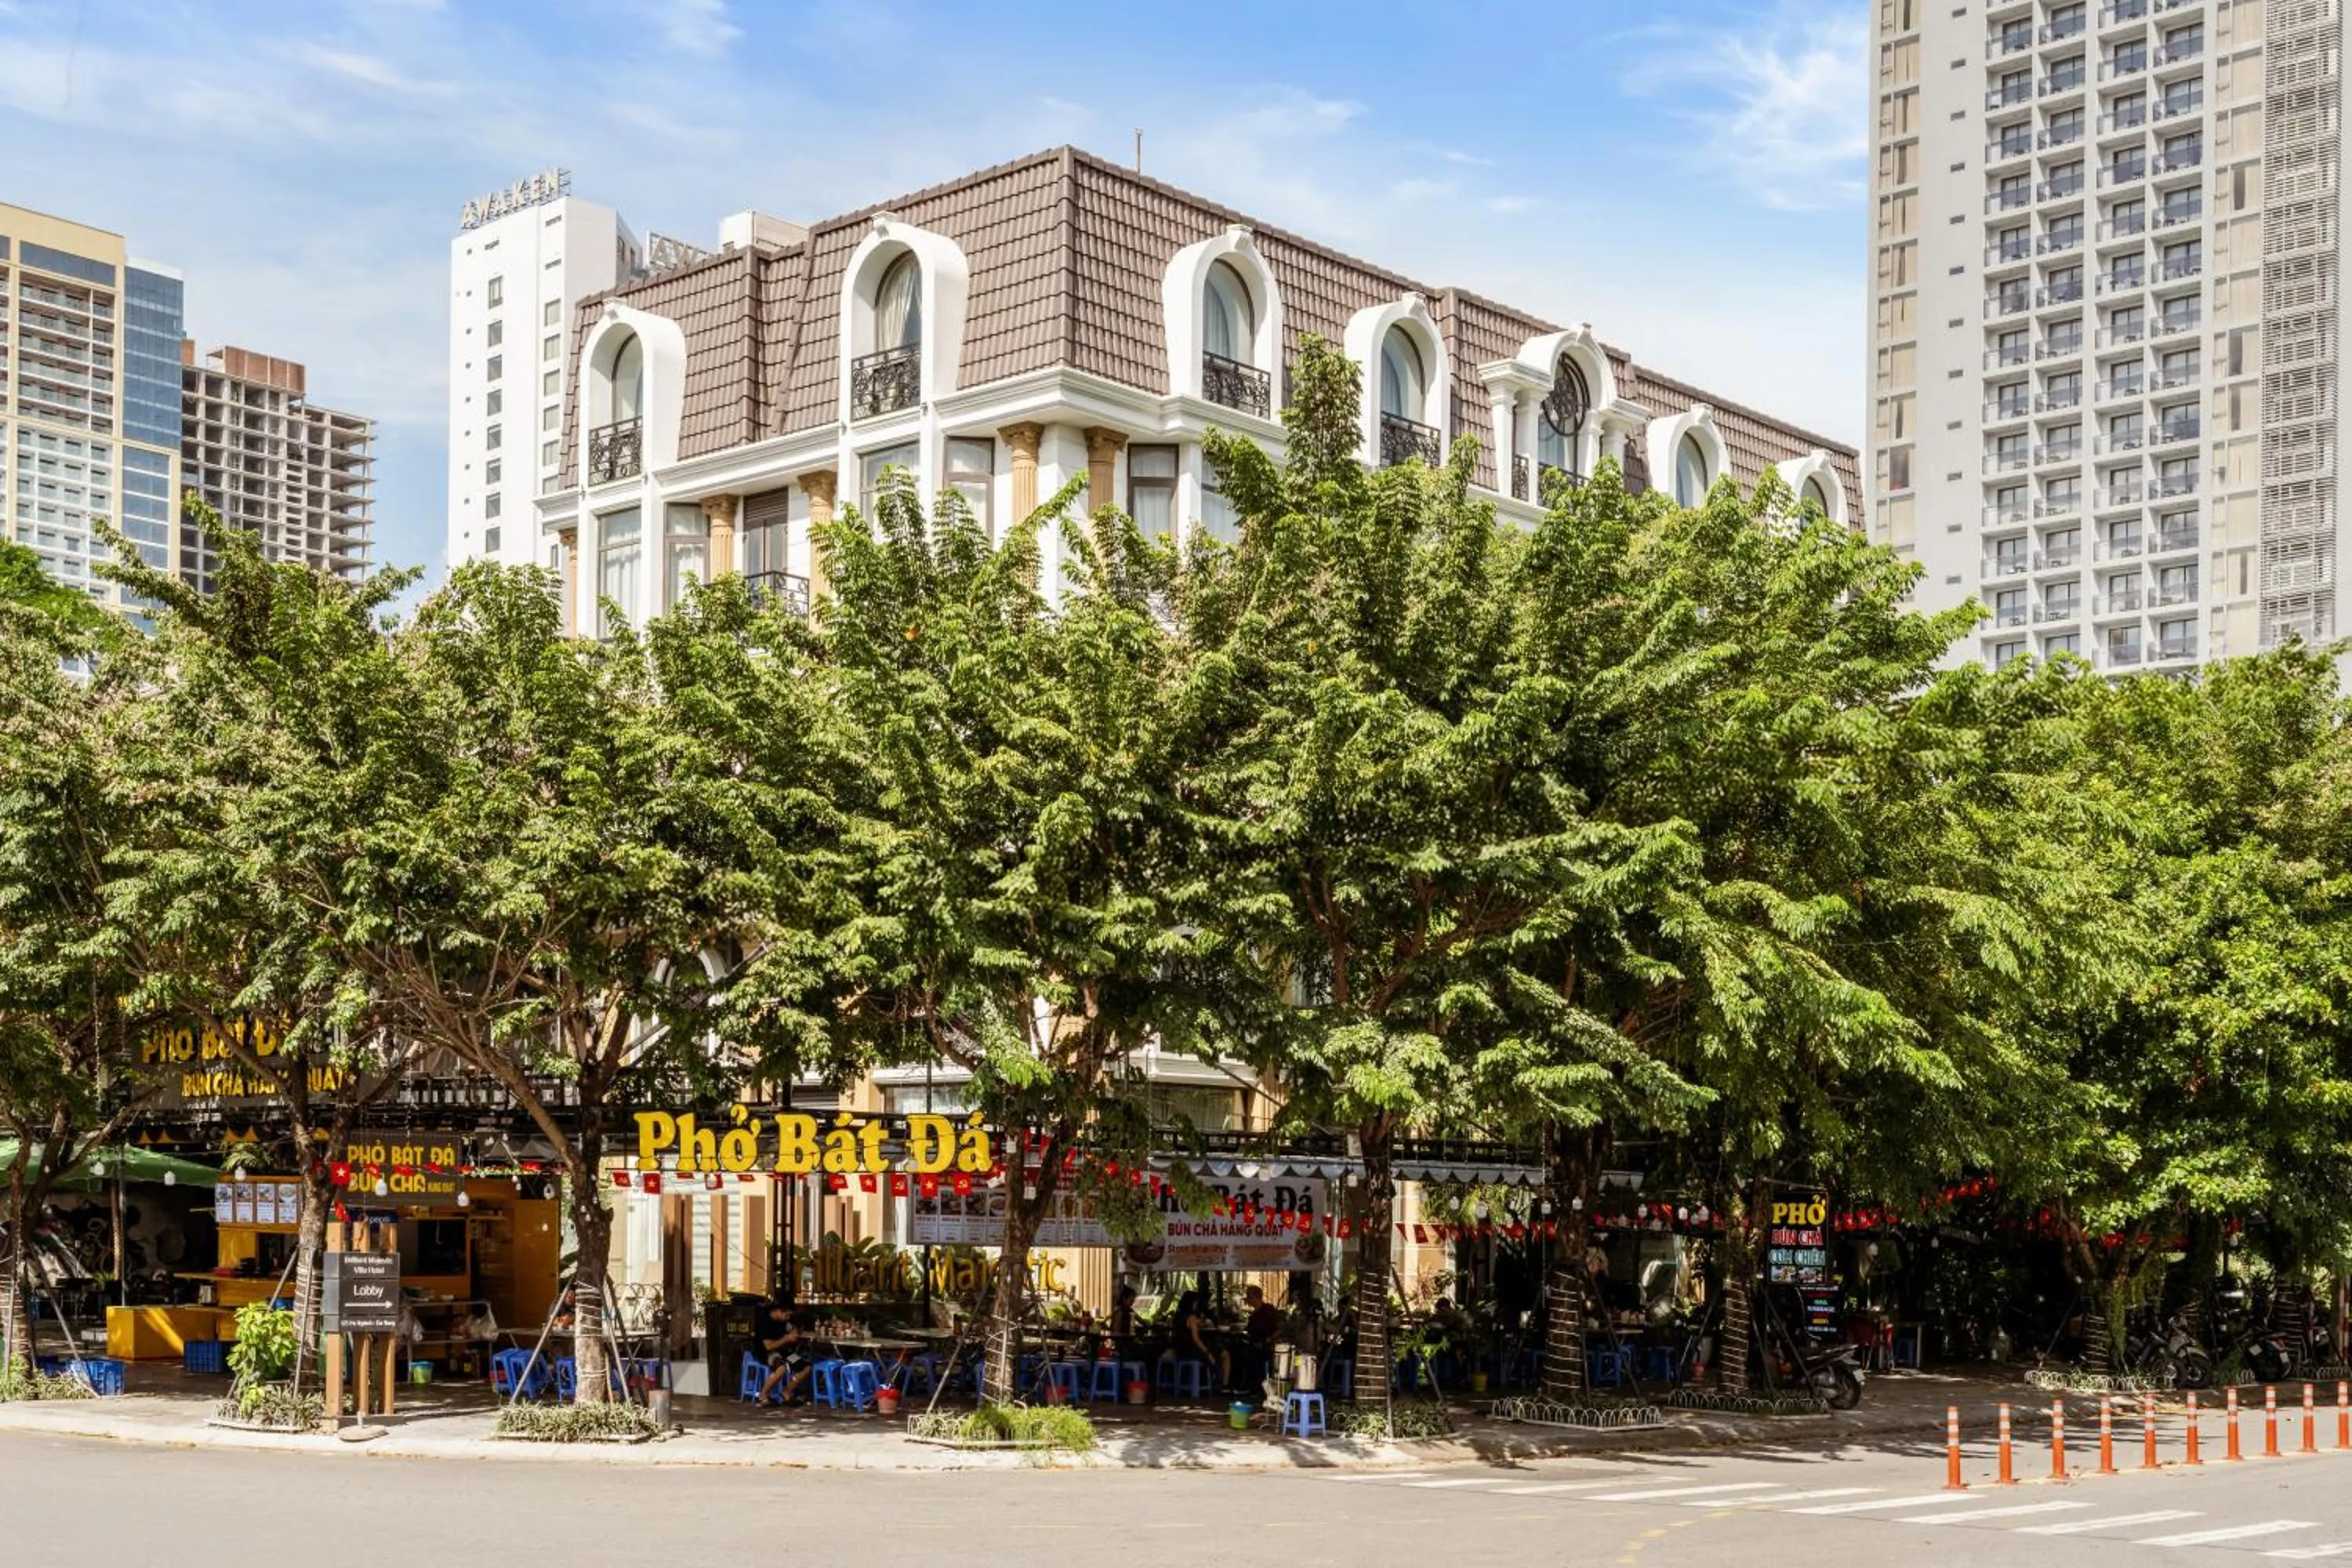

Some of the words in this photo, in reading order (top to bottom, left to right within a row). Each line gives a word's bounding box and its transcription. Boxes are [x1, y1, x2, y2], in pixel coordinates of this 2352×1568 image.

[633, 1103, 762, 1172] Phở
[774, 1111, 890, 1174] Bát
[906, 1110, 994, 1174] Đá
[1275, 1185, 1314, 1214] Đá
[1772, 1194, 1826, 1225] PHỞ
[1167, 1219, 1191, 1236] BÚN
[794, 1245, 914, 1293] rilliant
[929, 1245, 1066, 1294] Majtic
[354, 1285, 384, 1299] Lobby
